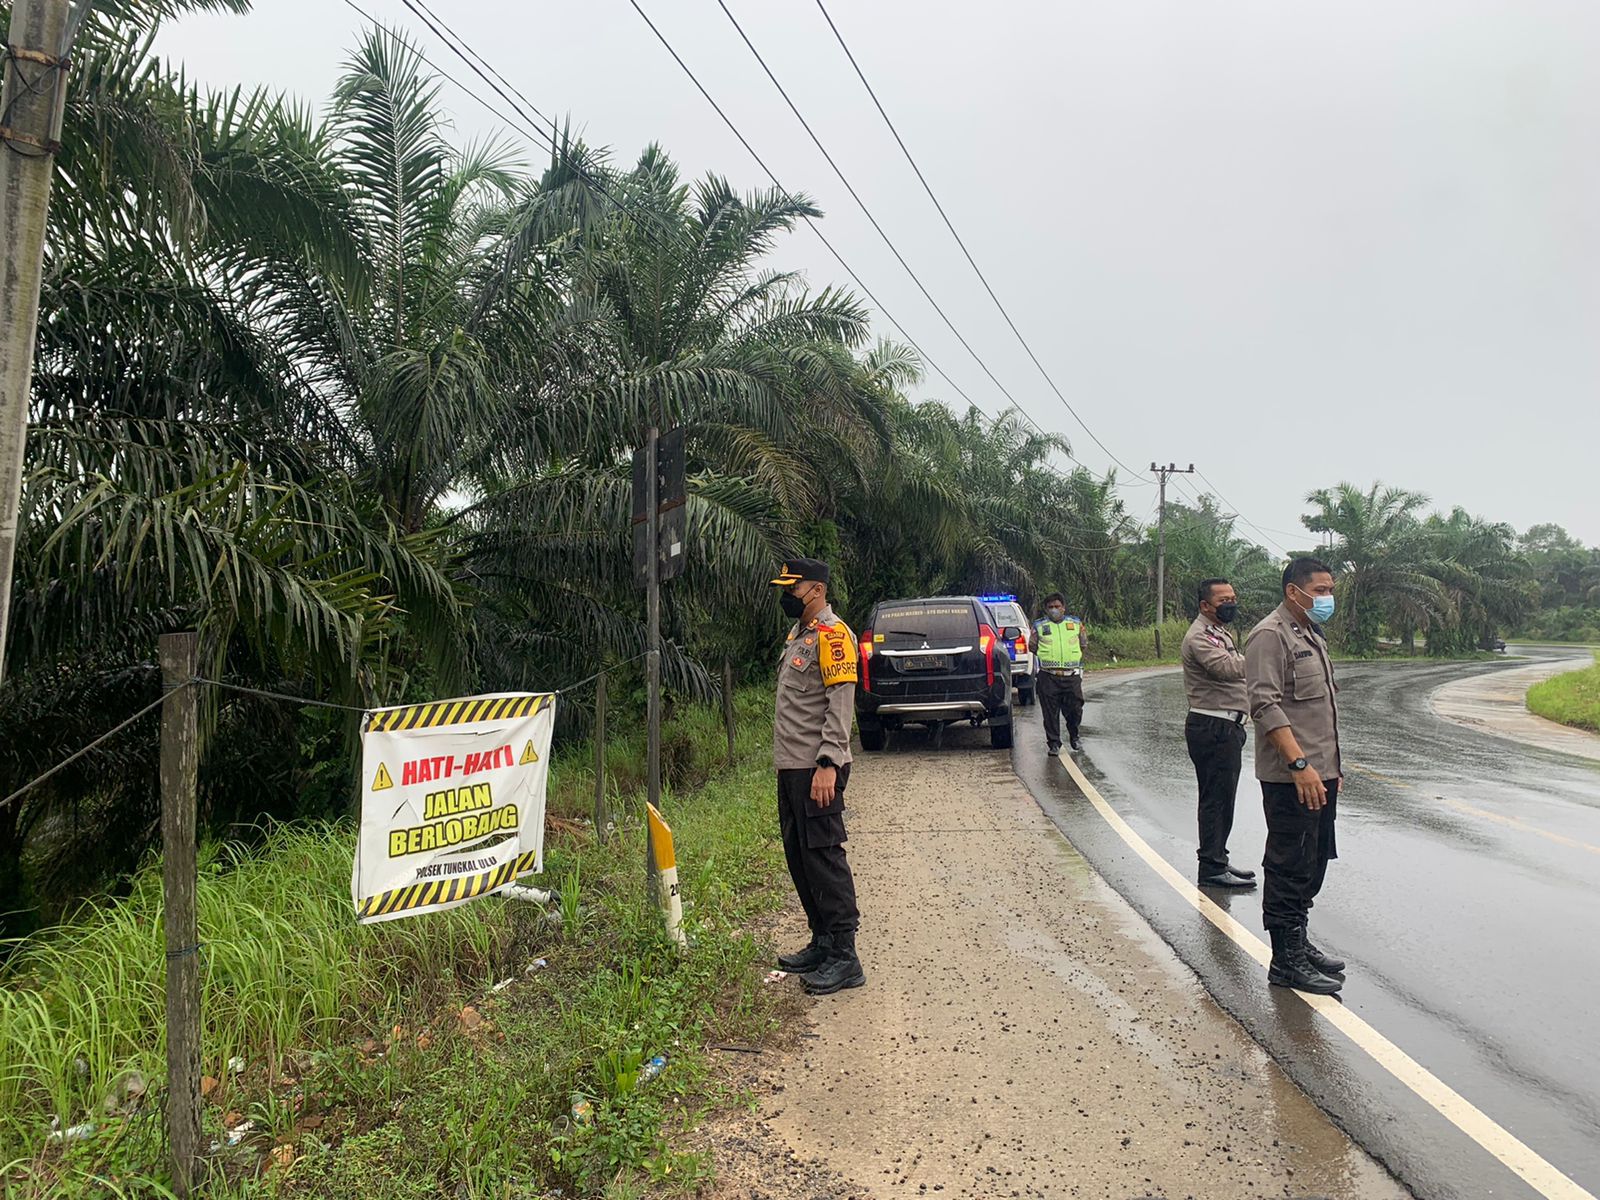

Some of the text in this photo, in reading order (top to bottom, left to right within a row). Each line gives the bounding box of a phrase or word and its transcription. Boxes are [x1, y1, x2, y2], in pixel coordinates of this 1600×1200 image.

[402, 745, 513, 785] HATI-HATI
[424, 783, 491, 820] JALAN
[389, 804, 517, 857] BERLOBANG
[416, 856, 498, 880] POLSEK TUNGKAL ULU
